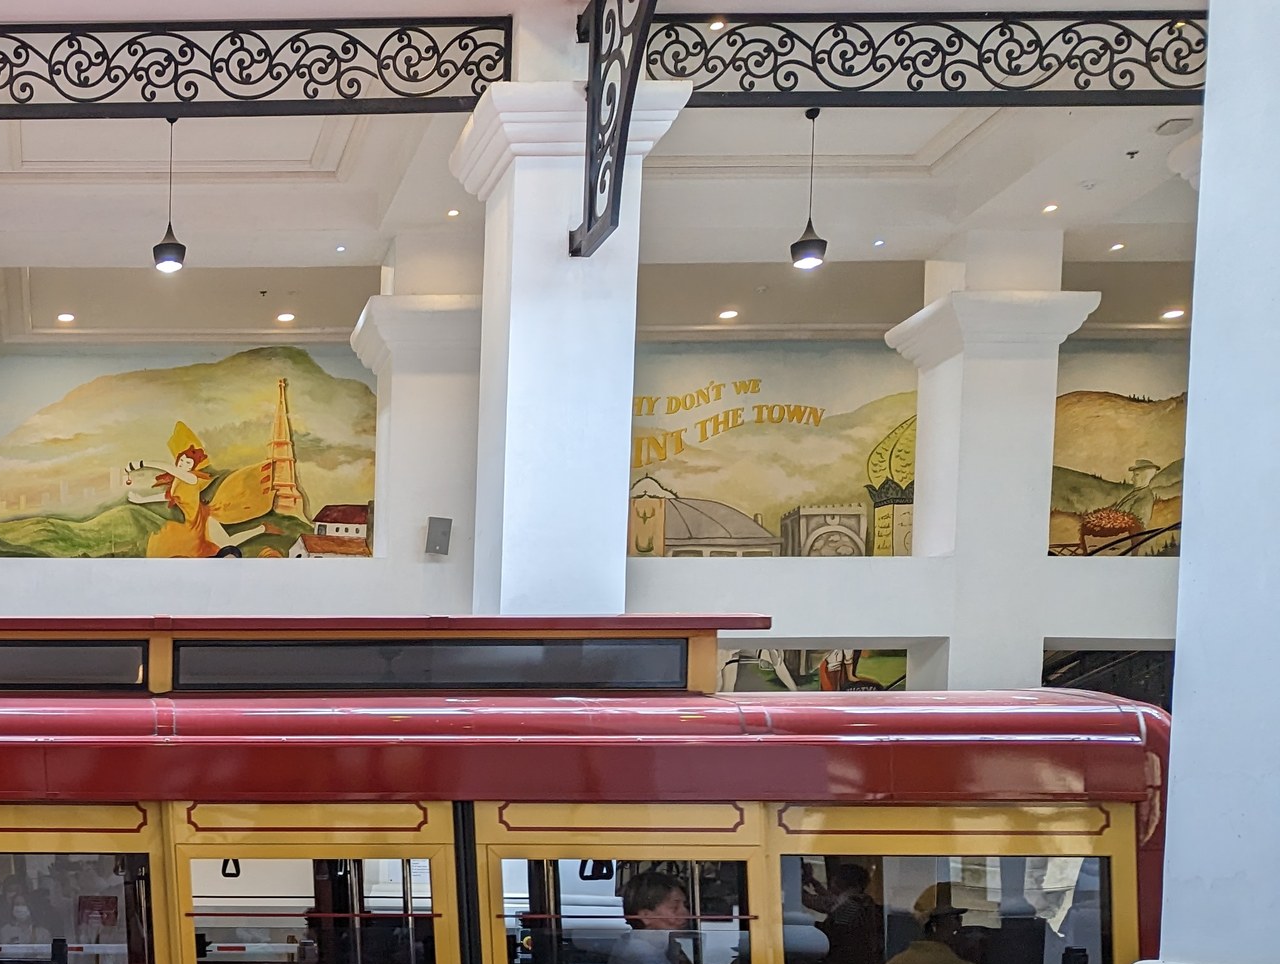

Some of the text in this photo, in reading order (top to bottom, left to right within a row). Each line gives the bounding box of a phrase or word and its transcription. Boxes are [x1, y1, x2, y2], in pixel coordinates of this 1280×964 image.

[731, 378, 762, 395] WE
[631, 404, 826, 469] INT THE TOWN
